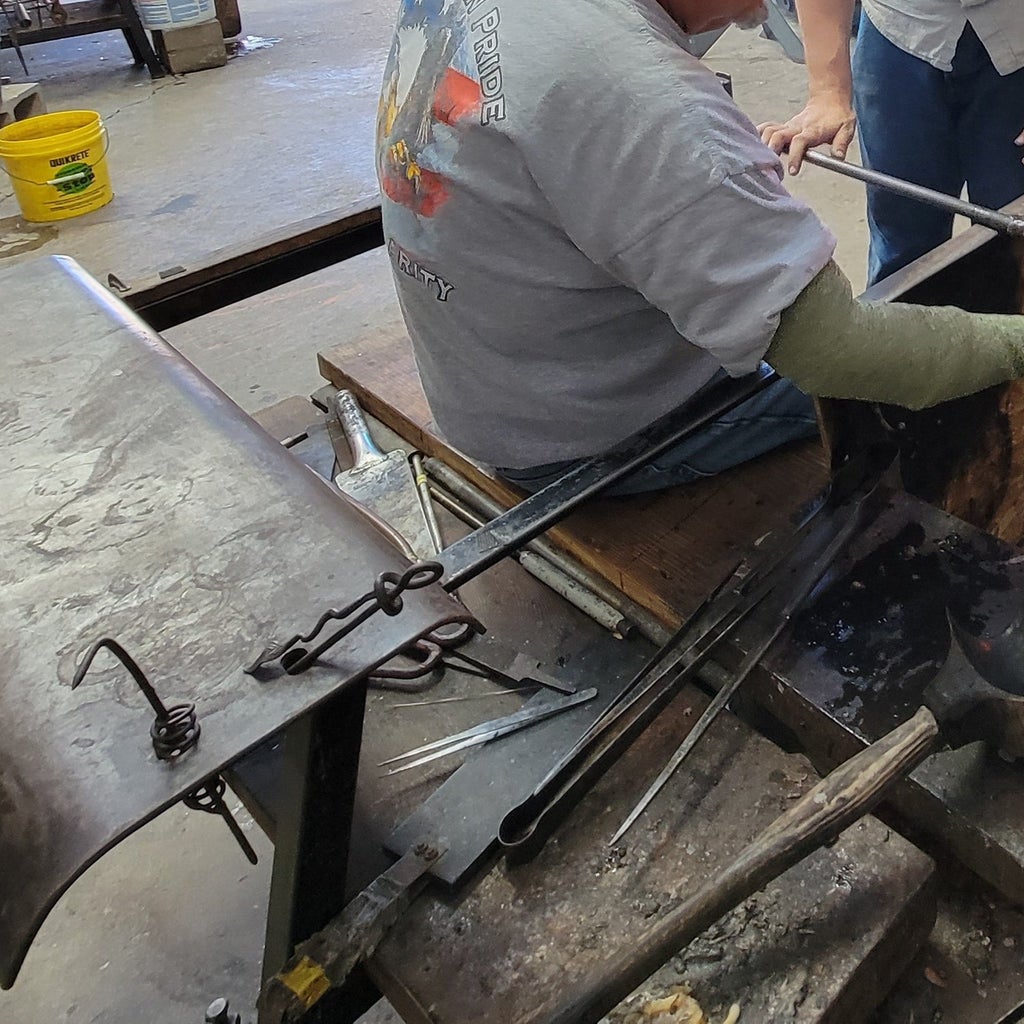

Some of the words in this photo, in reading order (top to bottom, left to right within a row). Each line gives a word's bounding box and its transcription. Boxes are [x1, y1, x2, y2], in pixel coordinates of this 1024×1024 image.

[471, 7, 506, 126] PRIDE
[49, 148, 90, 167] QUIKRETE
[388, 238, 455, 302] RITY
